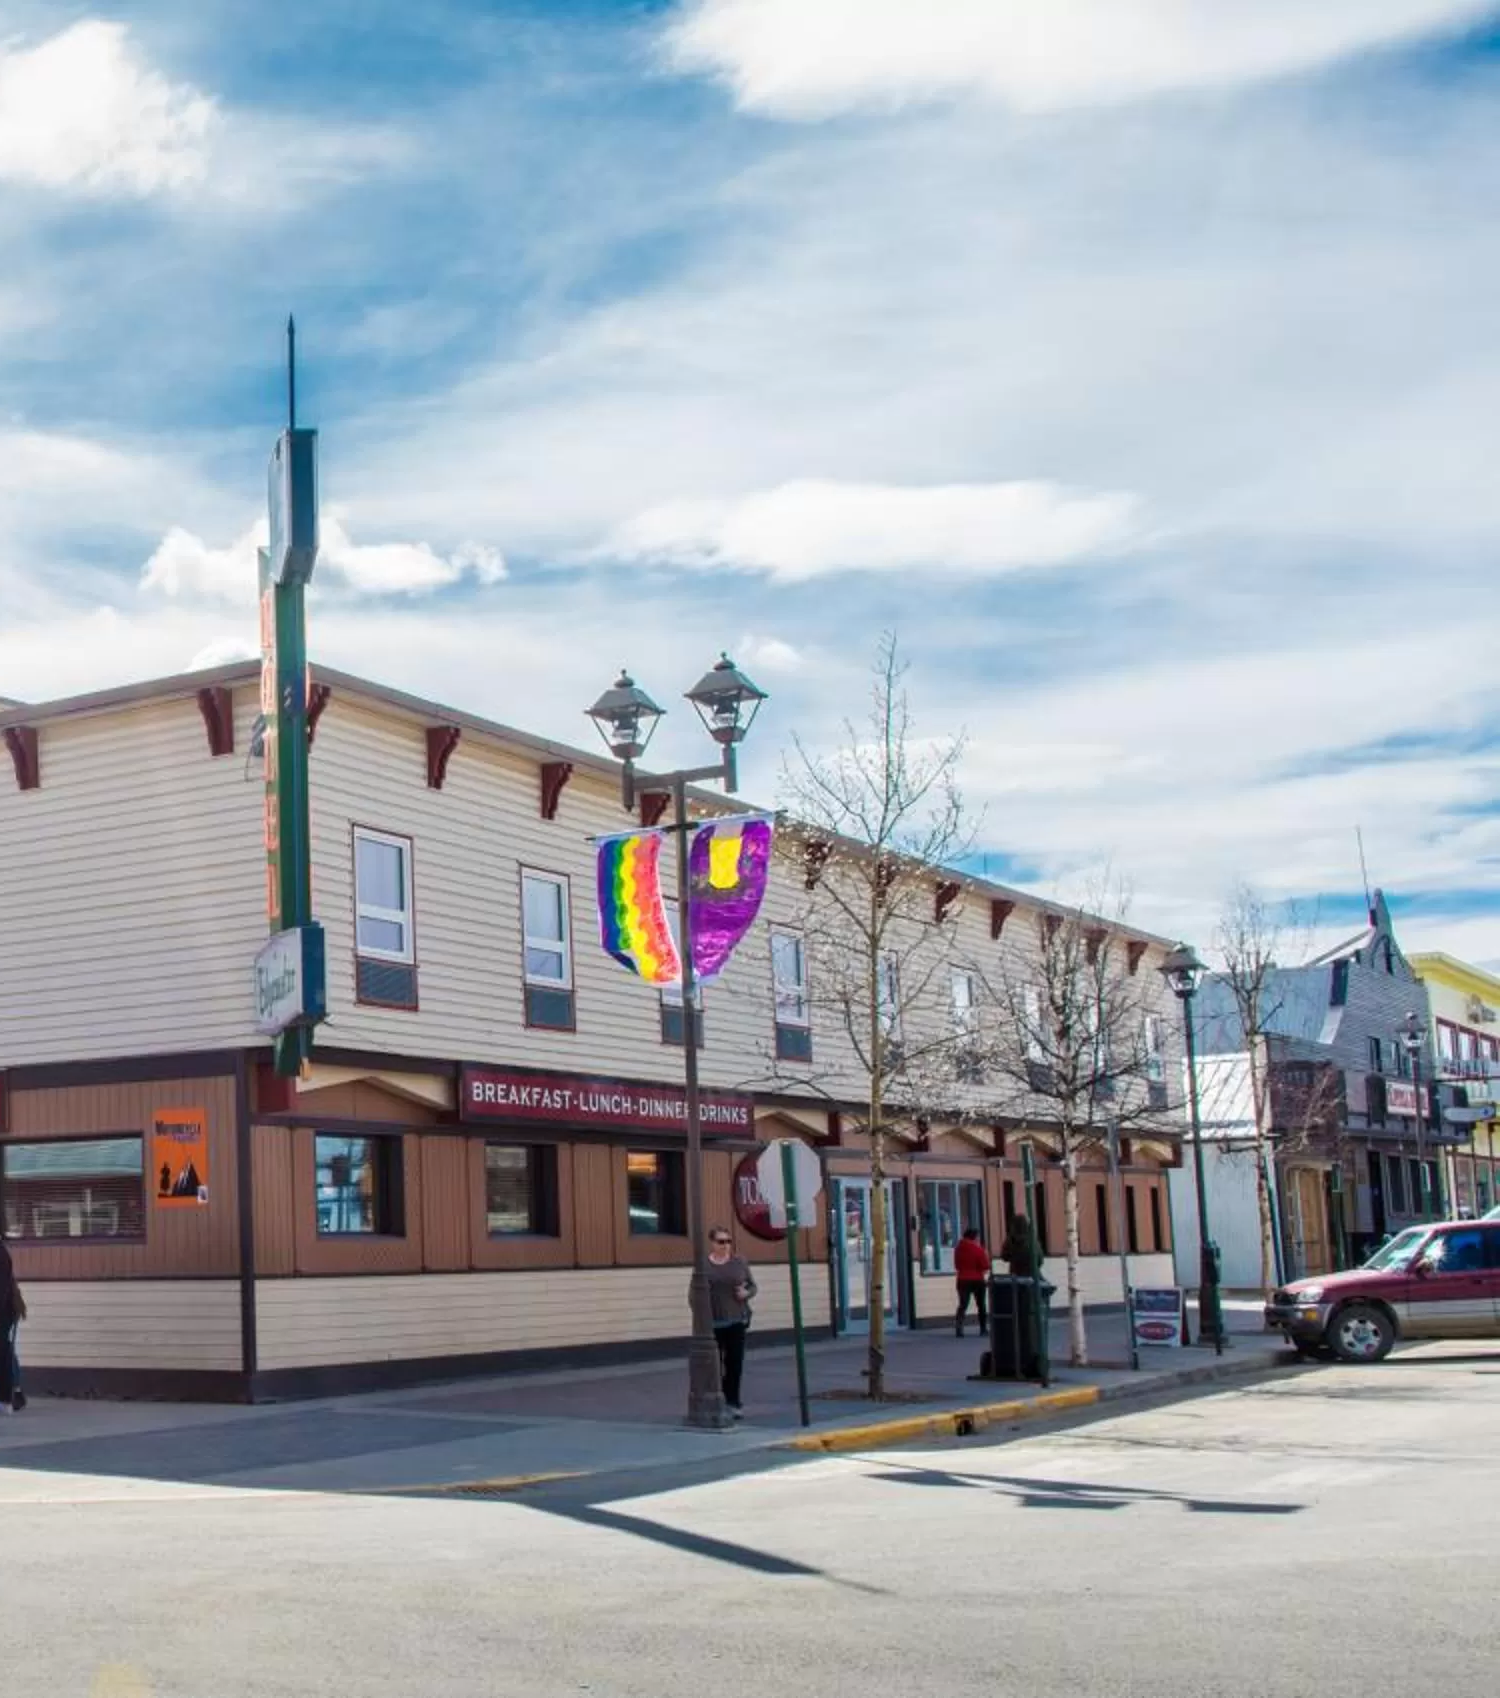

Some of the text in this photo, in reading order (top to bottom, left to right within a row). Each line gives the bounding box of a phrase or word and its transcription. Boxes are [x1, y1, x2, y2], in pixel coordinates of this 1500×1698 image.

[472, 1081, 571, 1109] BREAKFAST
[579, 1092, 631, 1115] LUNCH
[699, 1103, 748, 1124] DRINKS
